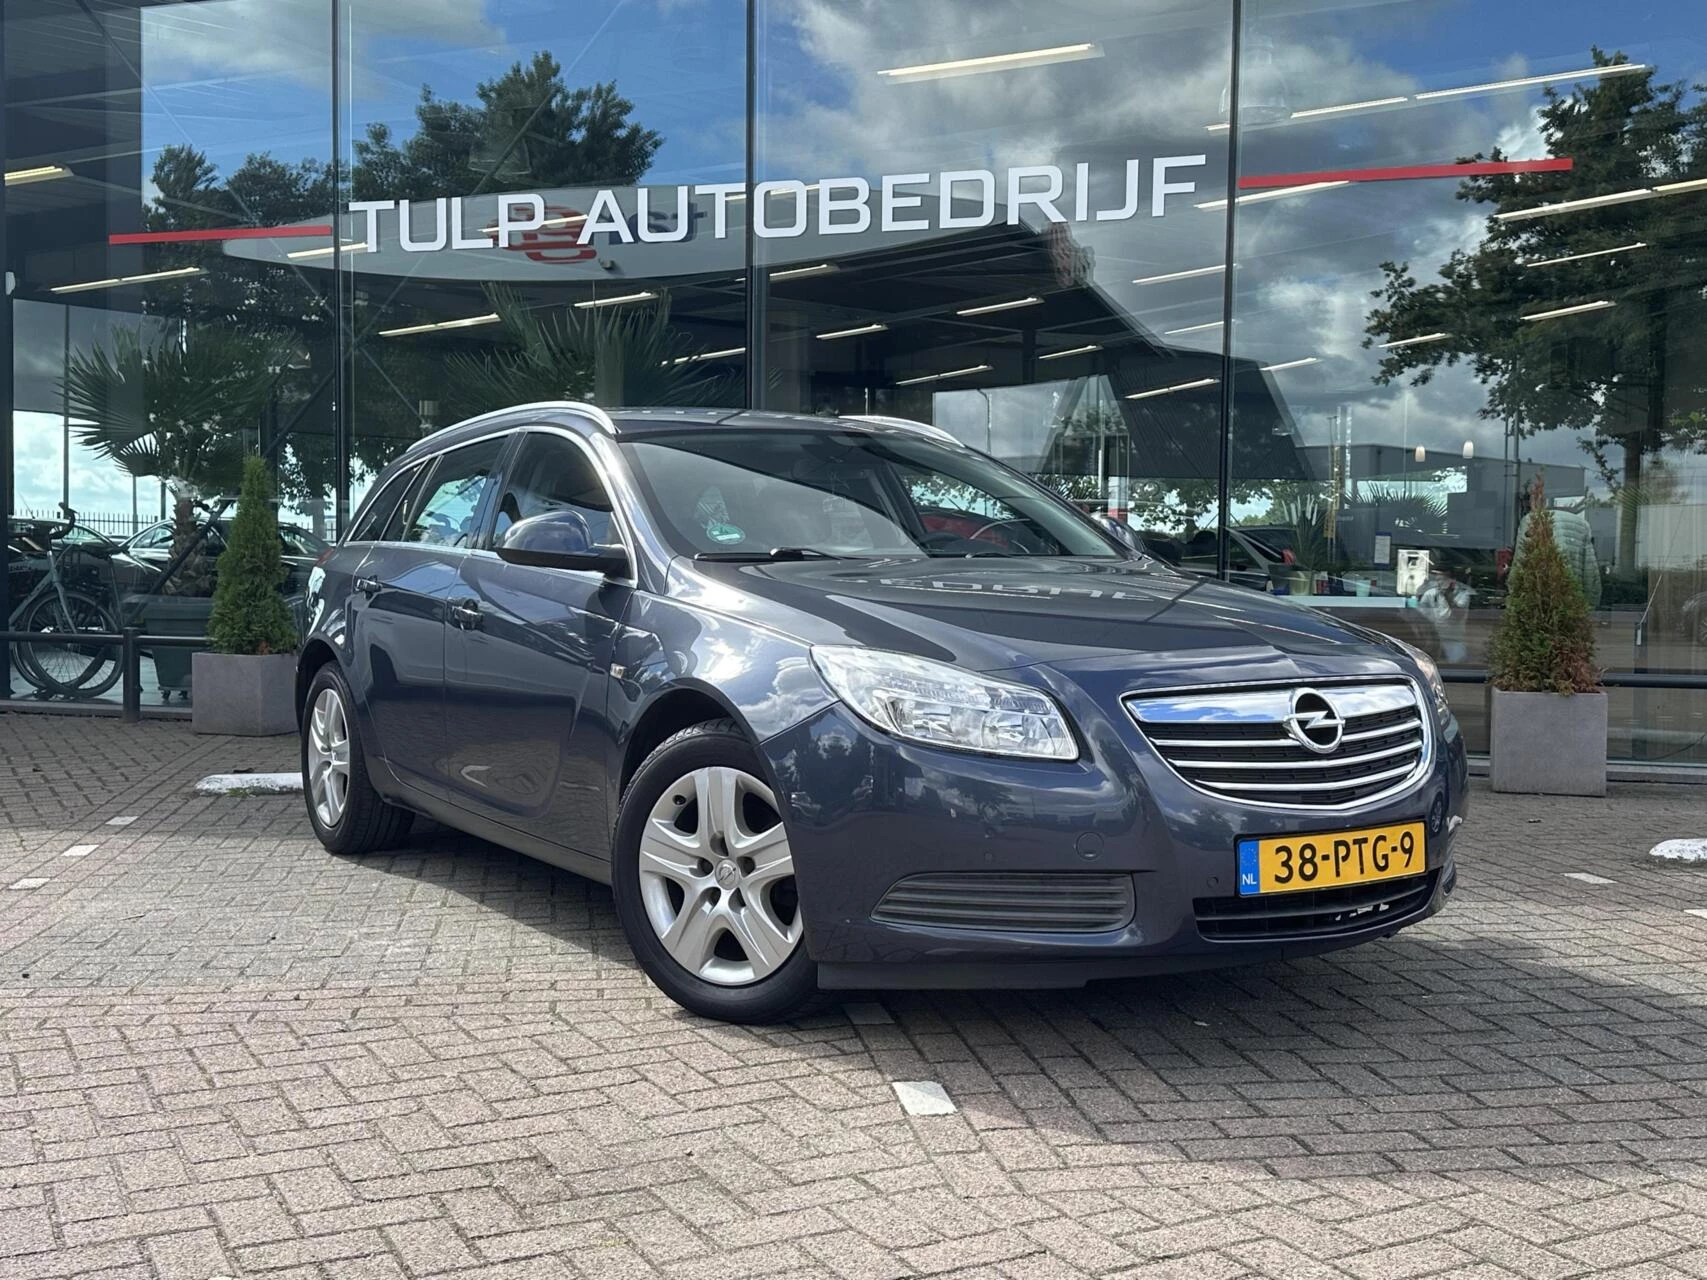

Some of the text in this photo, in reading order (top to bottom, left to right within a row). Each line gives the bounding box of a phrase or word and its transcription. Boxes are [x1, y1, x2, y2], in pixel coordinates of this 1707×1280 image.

[348, 192, 546, 253] TULP
[577, 154, 1206, 245] AUTOBEDRIJF
[1242, 873, 1257, 886] NL
[1274, 831, 1415, 884] 38-PTG-9
